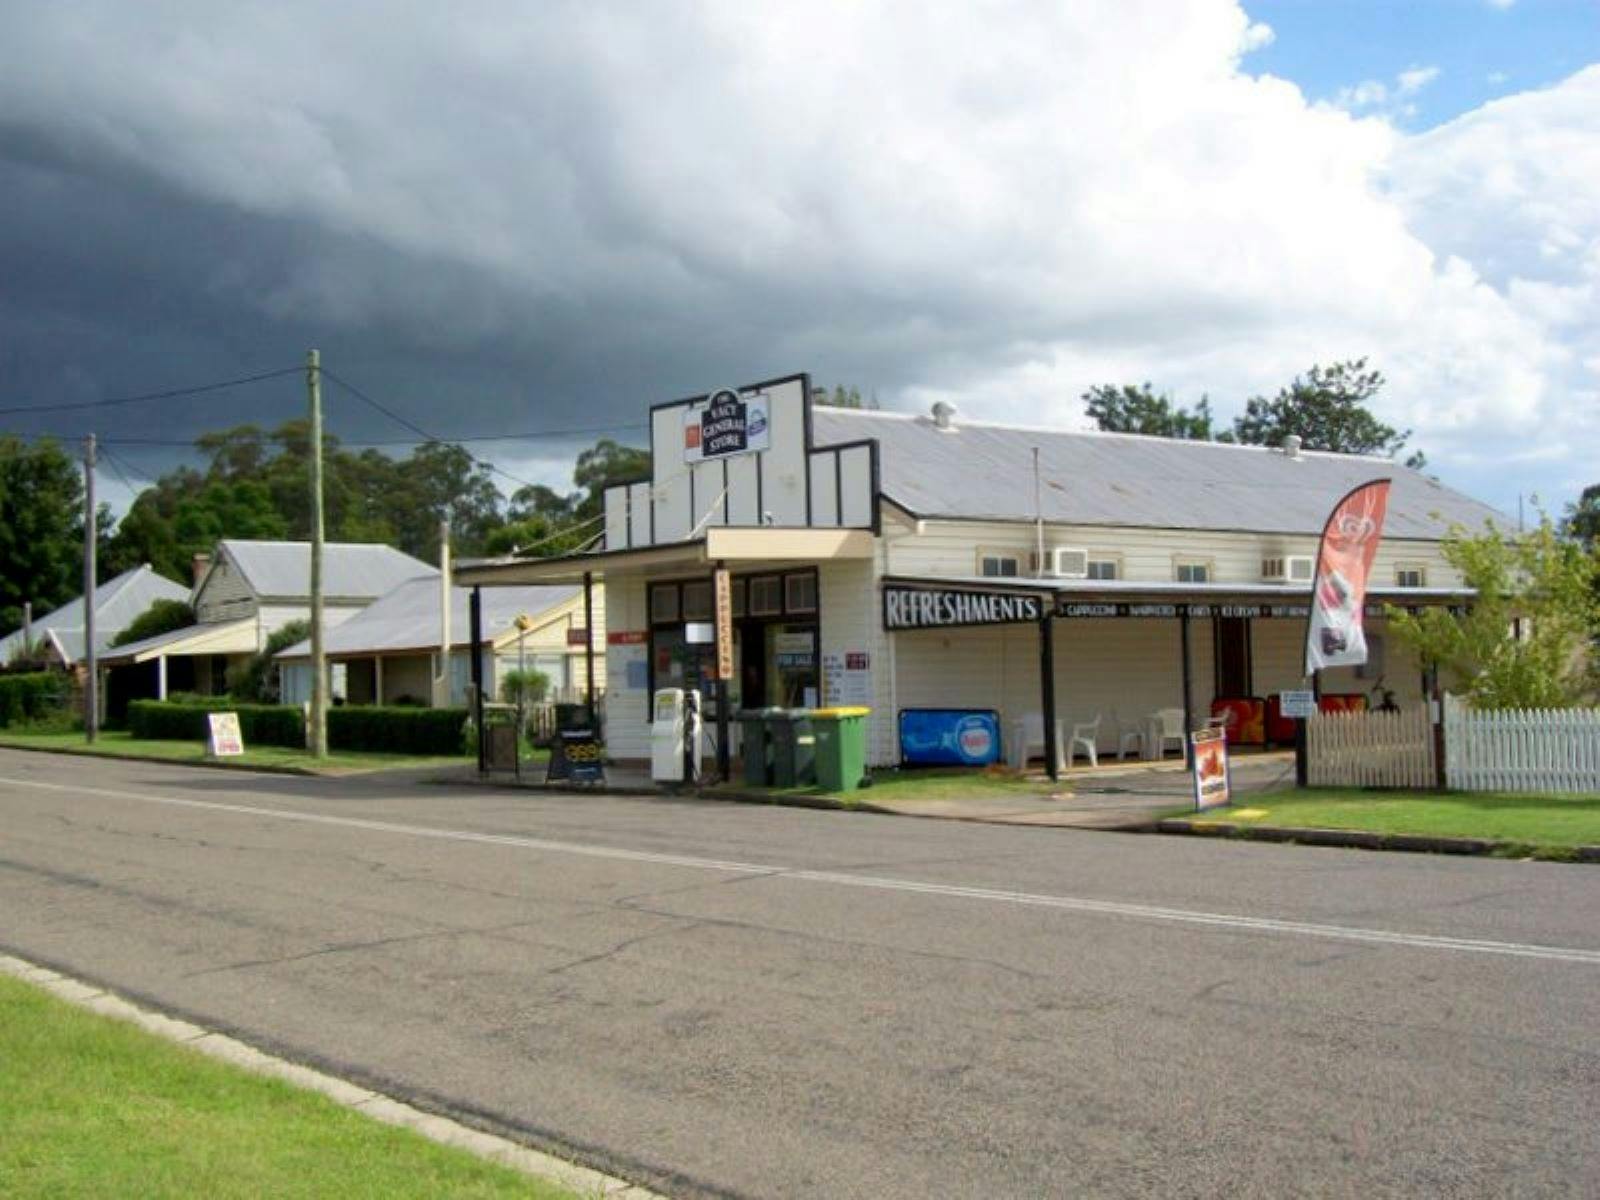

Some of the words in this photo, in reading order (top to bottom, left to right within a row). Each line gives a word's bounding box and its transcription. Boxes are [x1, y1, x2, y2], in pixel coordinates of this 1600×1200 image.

[703, 418, 745, 438] GENERAL
[709, 433, 741, 451] STORE
[886, 590, 1037, 627] REFRESHMENTS
